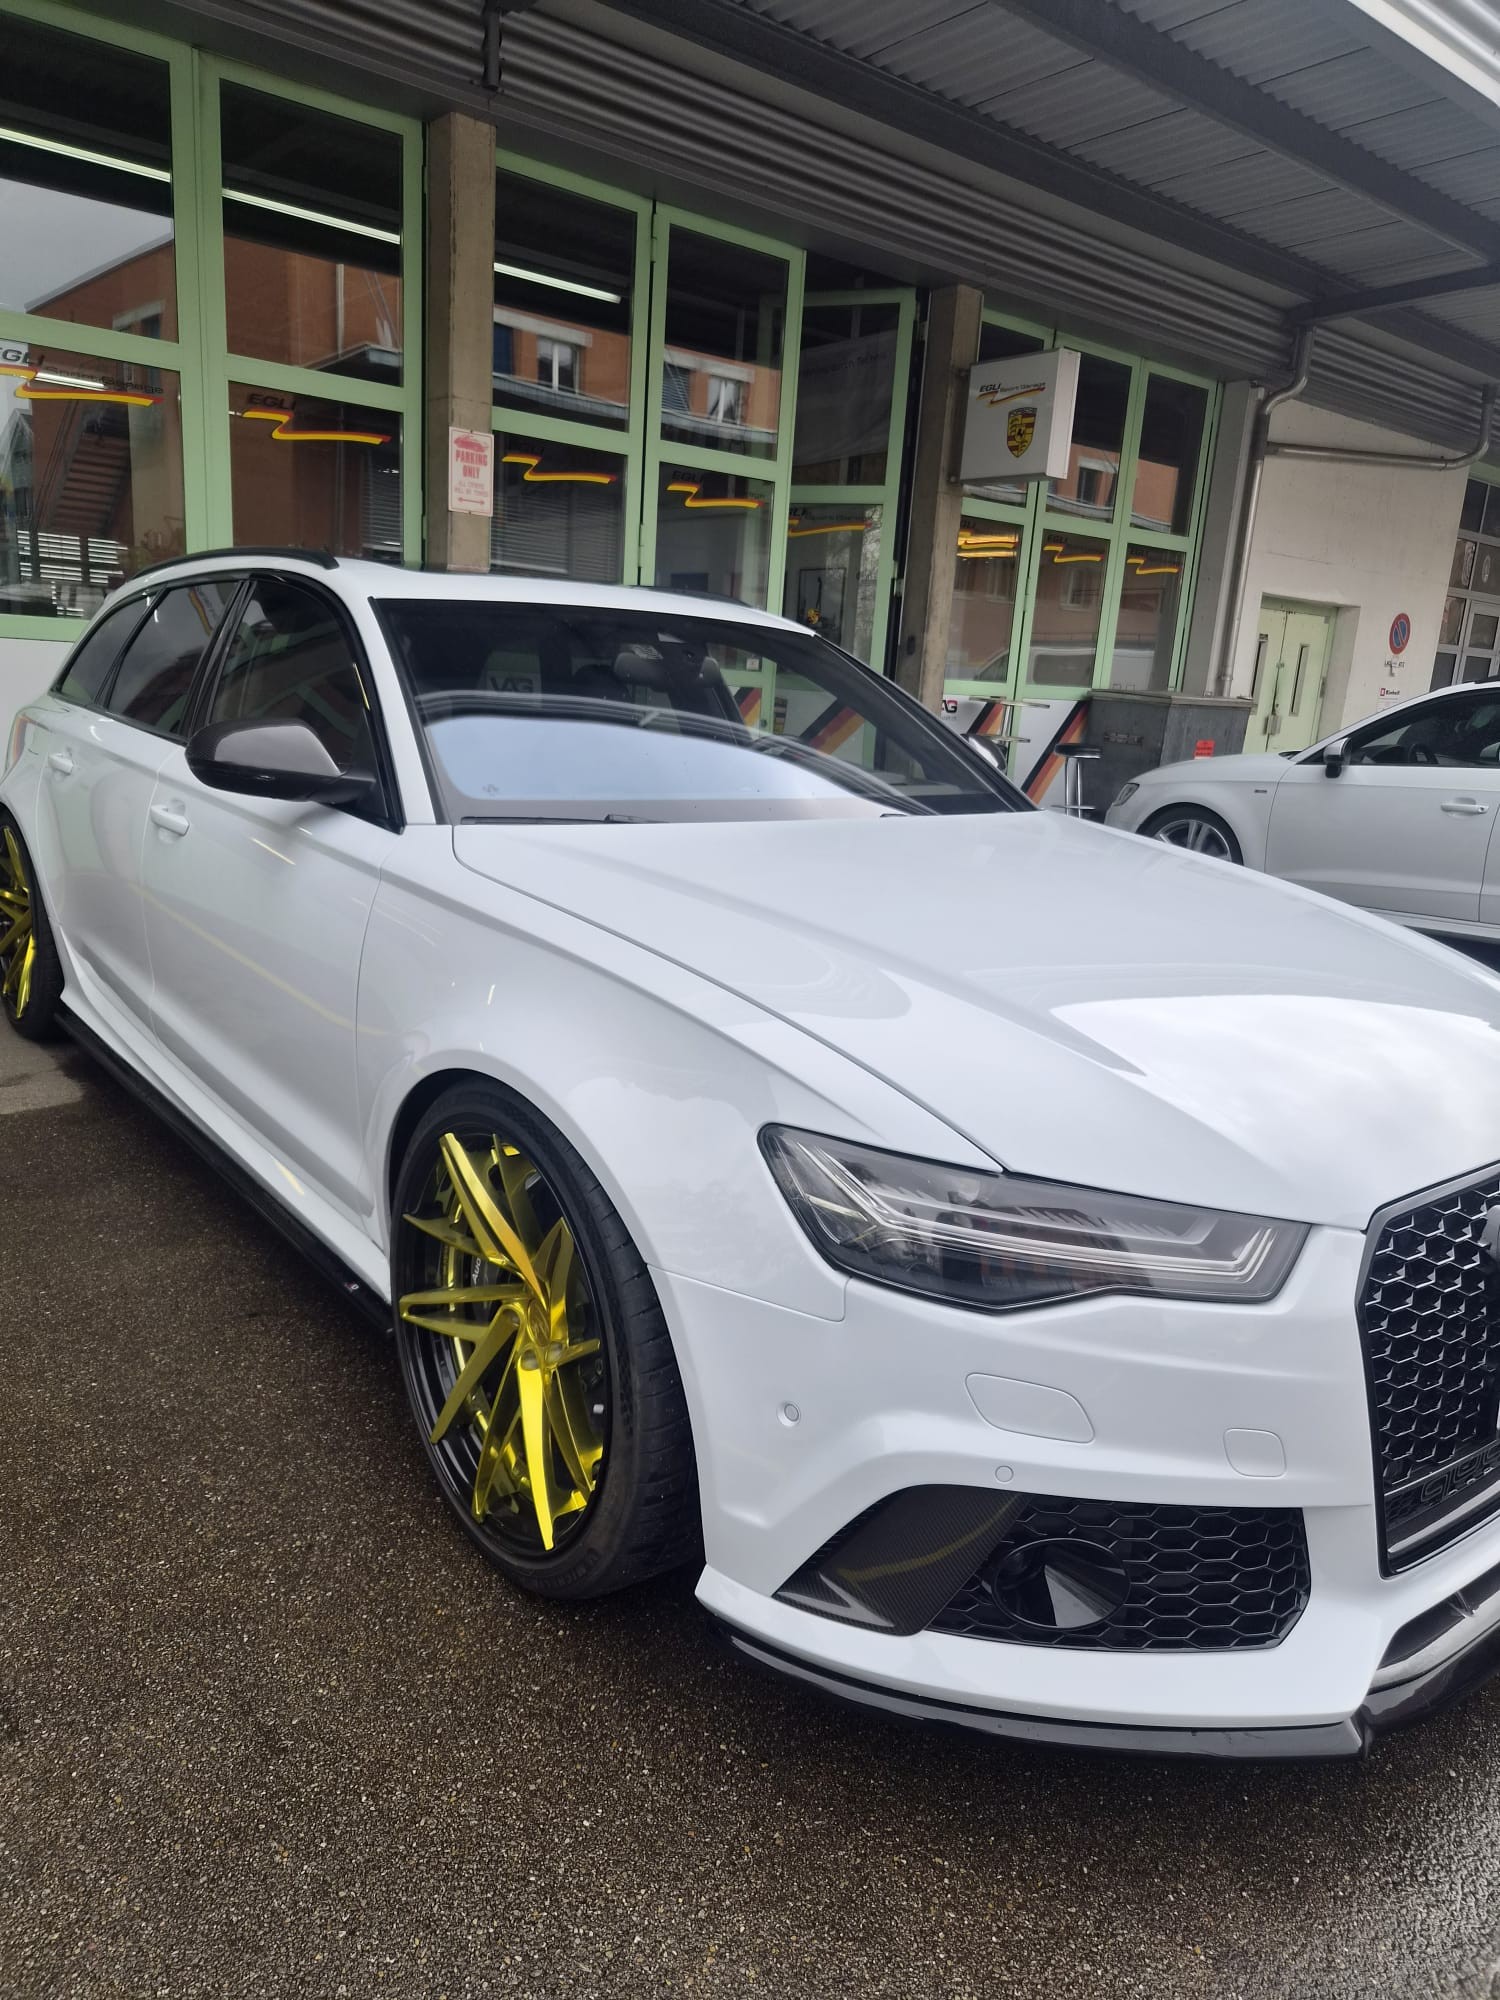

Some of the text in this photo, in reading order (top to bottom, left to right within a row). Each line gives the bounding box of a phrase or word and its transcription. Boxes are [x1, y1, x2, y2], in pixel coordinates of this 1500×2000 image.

[0, 347, 45, 365] GLI
[979, 383, 1002, 393] EGLI
[248, 393, 296, 410] EGLI
[455, 449, 488, 467] PARKING
[463, 465, 480, 479] ONLY
